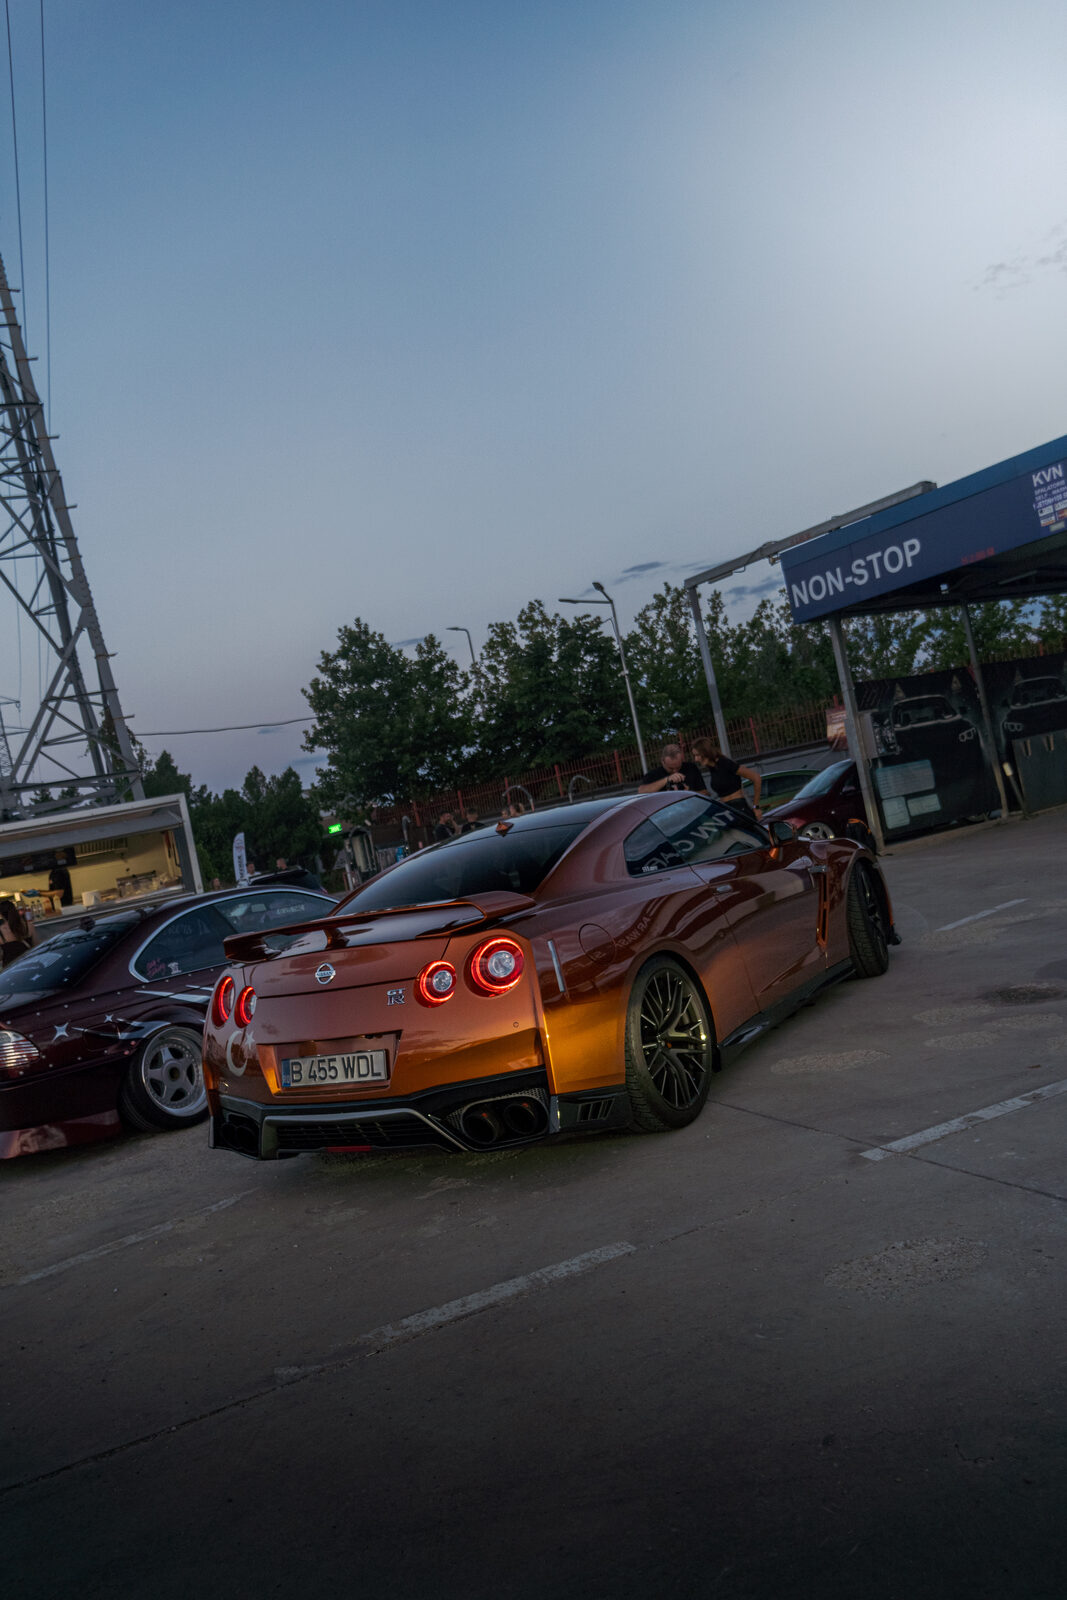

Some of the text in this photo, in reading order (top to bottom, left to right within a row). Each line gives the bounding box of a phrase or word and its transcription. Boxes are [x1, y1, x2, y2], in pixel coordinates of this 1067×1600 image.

[1032, 464, 1063, 487] KVN
[791, 538, 921, 608] NON-STOP
[291, 1055, 382, 1083] B 455 WDL
